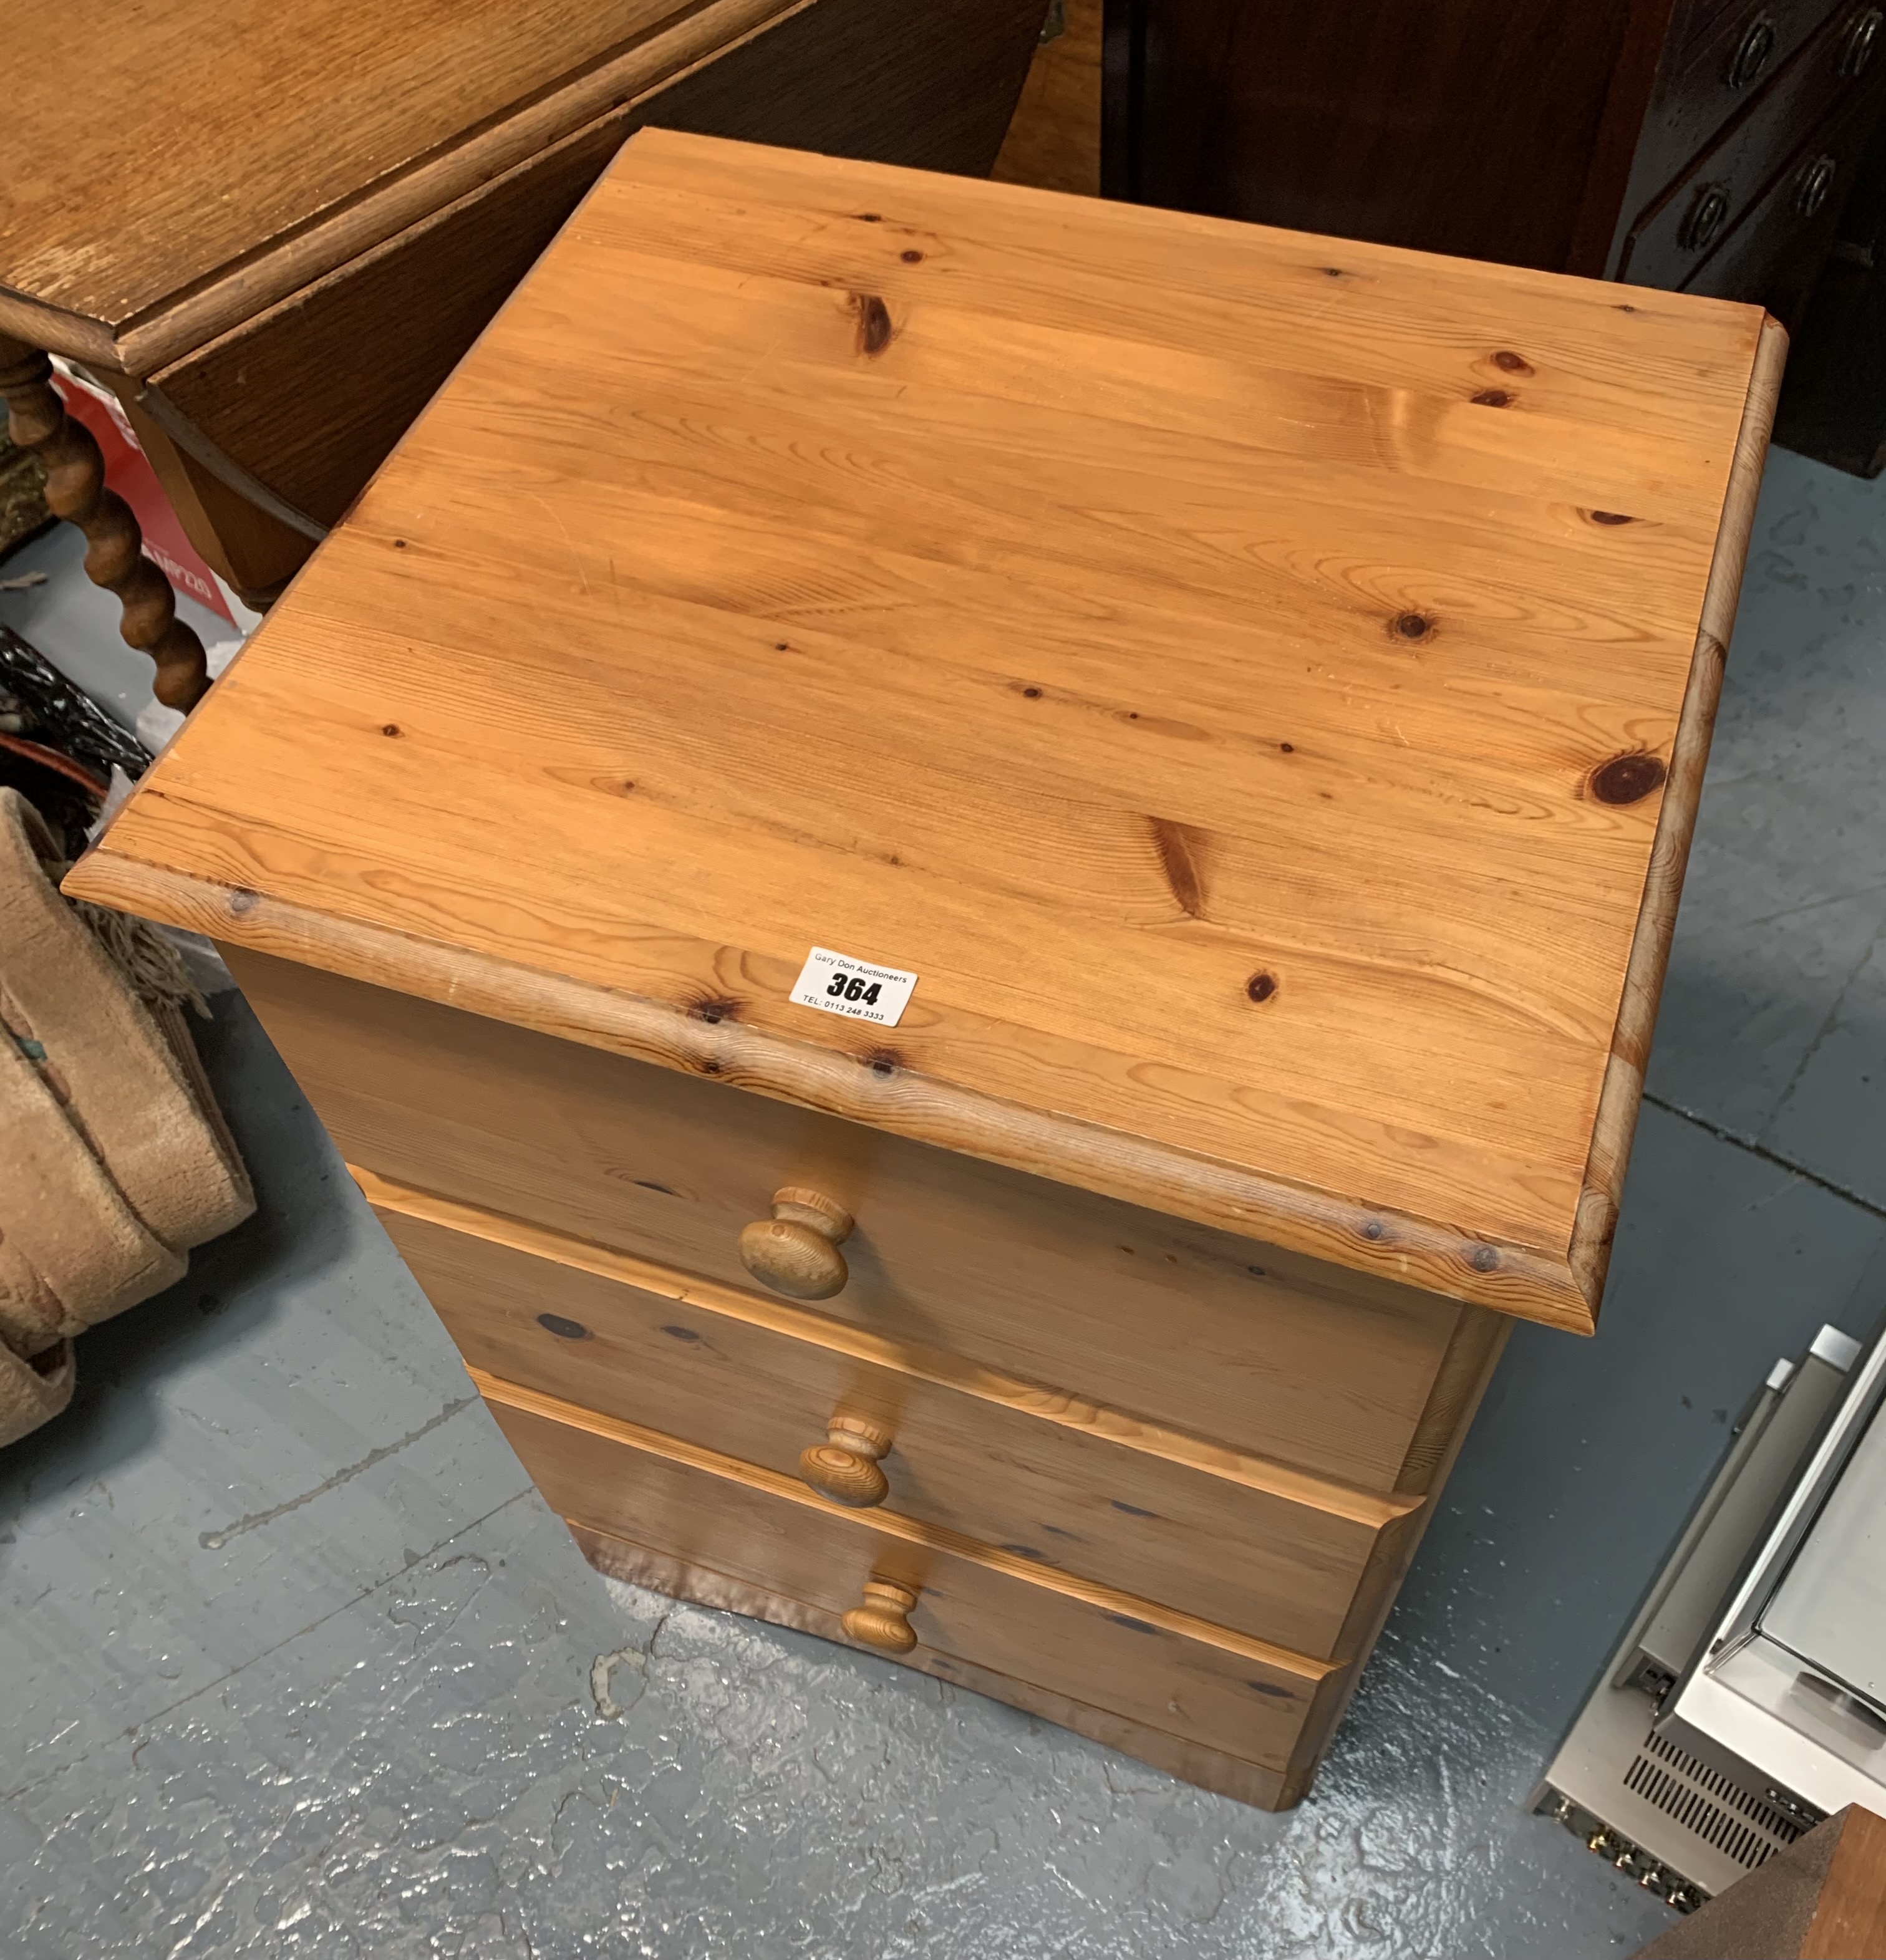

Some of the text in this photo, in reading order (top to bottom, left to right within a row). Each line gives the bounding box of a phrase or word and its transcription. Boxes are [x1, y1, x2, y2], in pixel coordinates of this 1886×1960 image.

[815, 953, 907, 983] Gary Don Auctioneers
[826, 972, 883, 1006] 364
[803, 995, 884, 1021] TEL: 0113 248 3333
